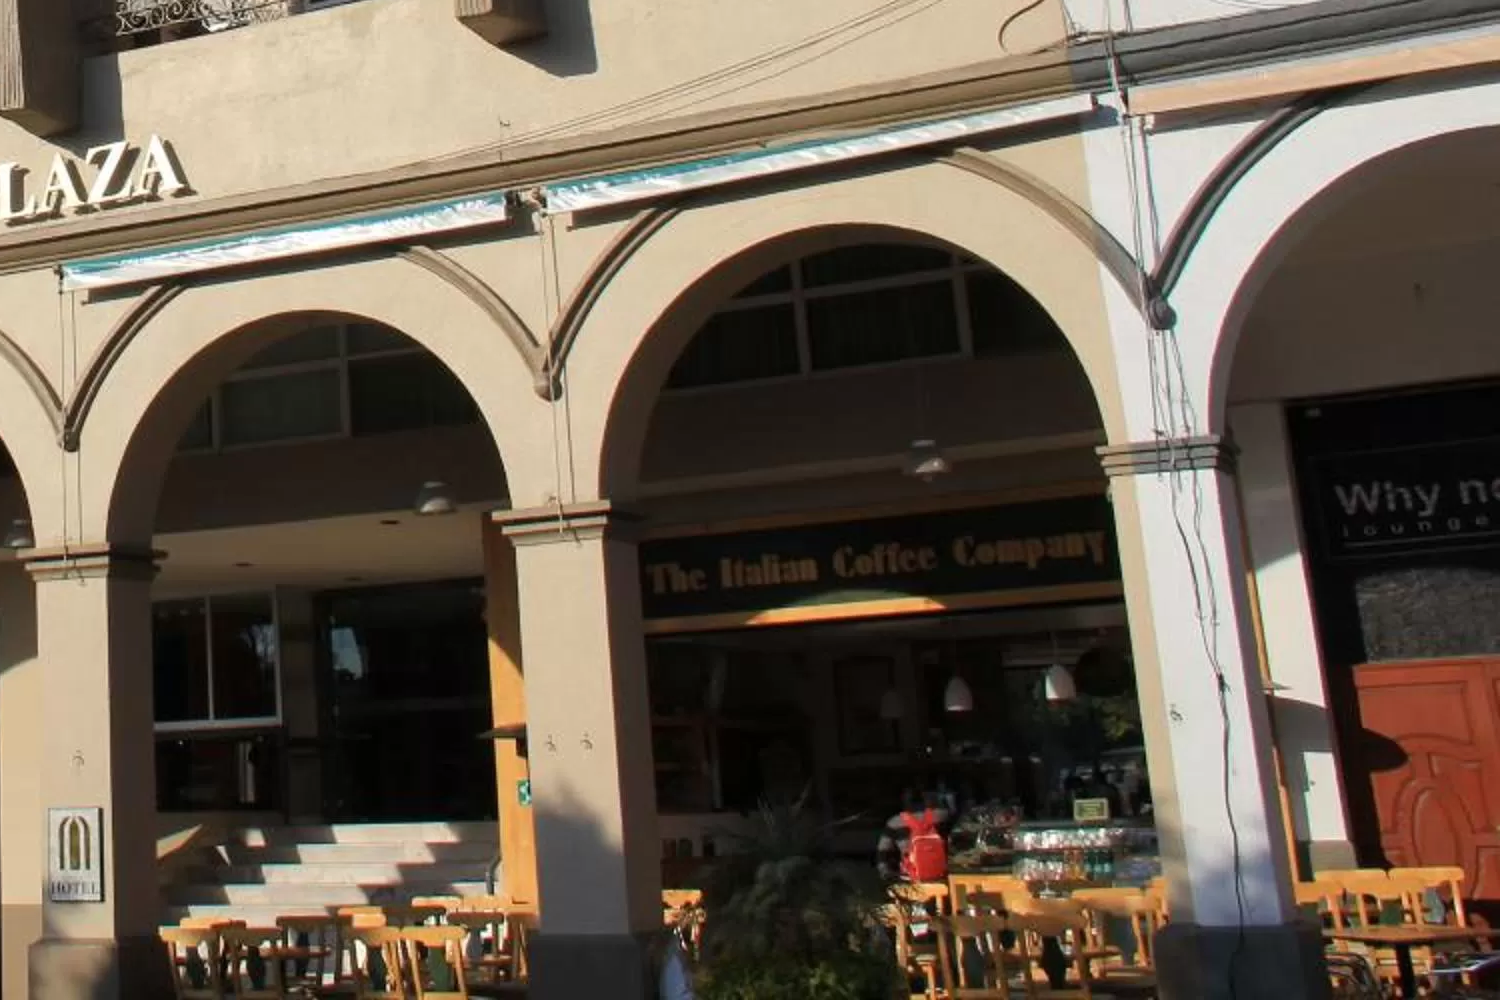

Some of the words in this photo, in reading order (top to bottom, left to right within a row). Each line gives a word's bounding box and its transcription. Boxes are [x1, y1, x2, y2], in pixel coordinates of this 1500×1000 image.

[1334, 480, 1441, 517] Why
[646, 561, 708, 595] The
[720, 552, 819, 589] Italian
[832, 544, 937, 579] Coffee
[952, 528, 1107, 571] Company
[51, 881, 98, 894] HOTEL
